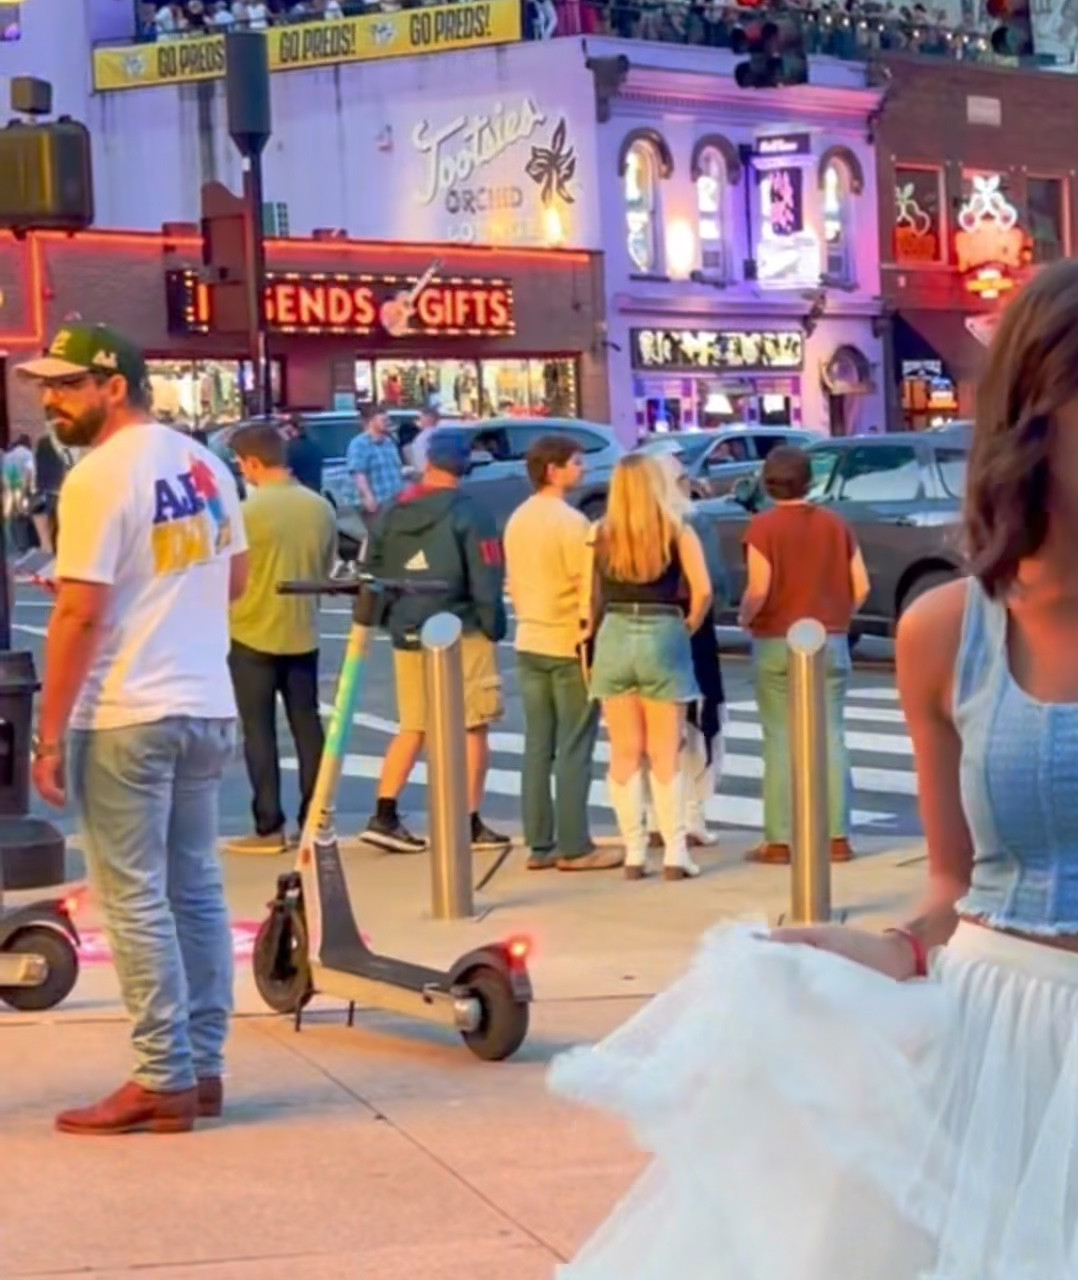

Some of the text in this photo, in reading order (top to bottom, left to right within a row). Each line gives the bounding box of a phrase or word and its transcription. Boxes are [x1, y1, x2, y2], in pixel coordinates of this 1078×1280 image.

[279, 24, 356, 62] GO PREDS!
[409, 4, 491, 46] GO PREDS!
[157, 46, 176, 77] GO
[417, 288, 508, 327] GIFTS
